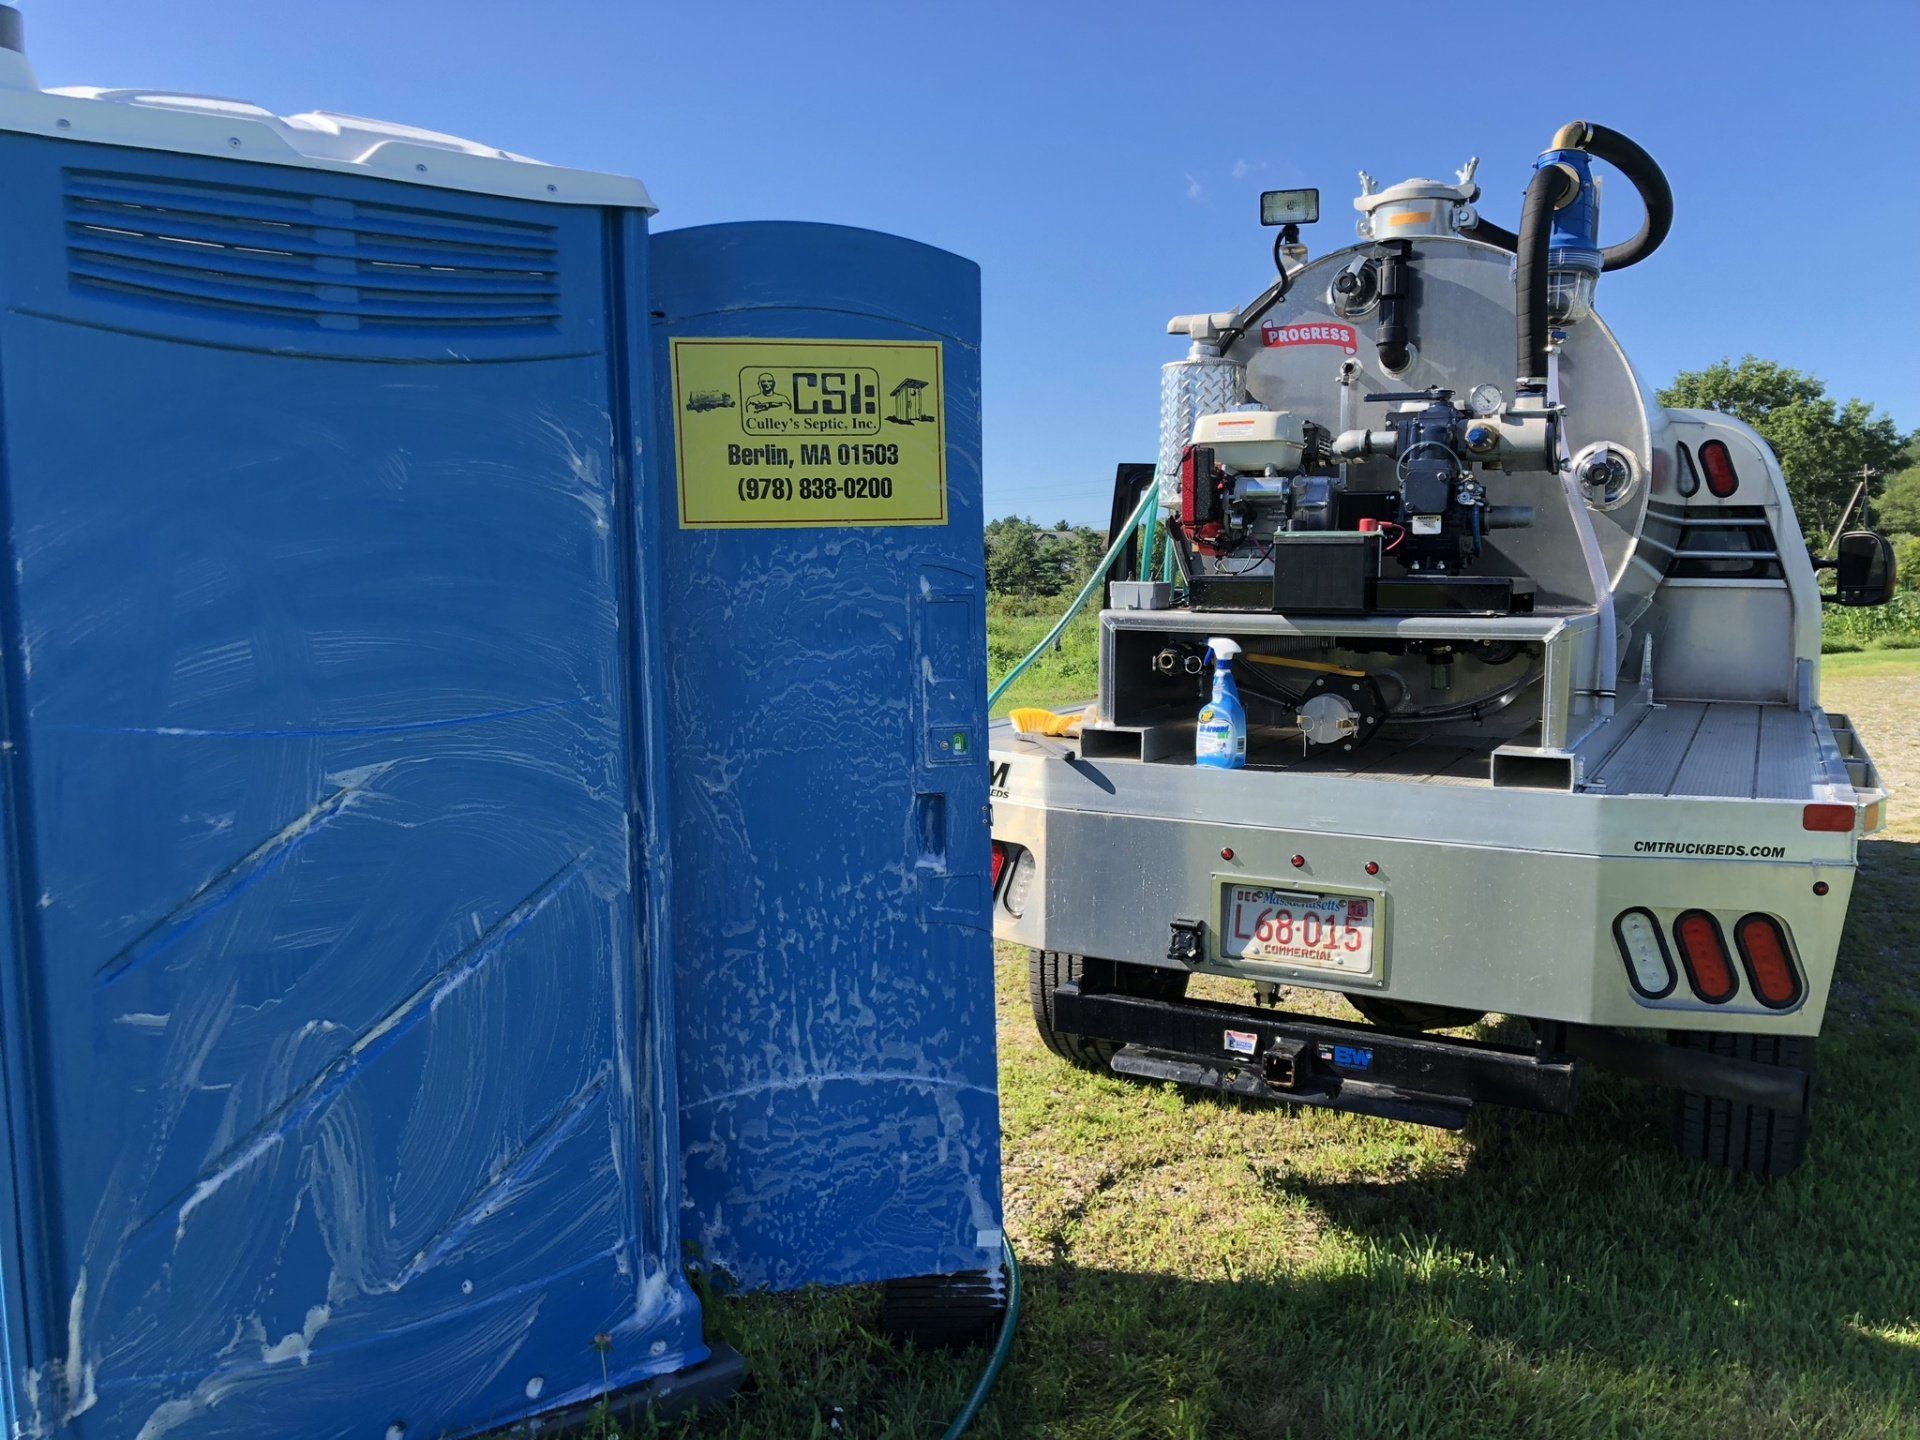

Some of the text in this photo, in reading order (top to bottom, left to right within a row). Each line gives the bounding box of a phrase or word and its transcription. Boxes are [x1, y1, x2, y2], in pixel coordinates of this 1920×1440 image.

[1268, 327, 1350, 343] PROGRESS
[746, 418, 877, 432] Culley's Septic, Inc.
[728, 444, 899, 468] Berlin, MA 01503
[738, 477, 893, 501] (978) 838-0200
[1634, 841, 1786, 858] CMTRUCKBEDS.COM
[1264, 944, 1334, 961] COMMERCIAL
